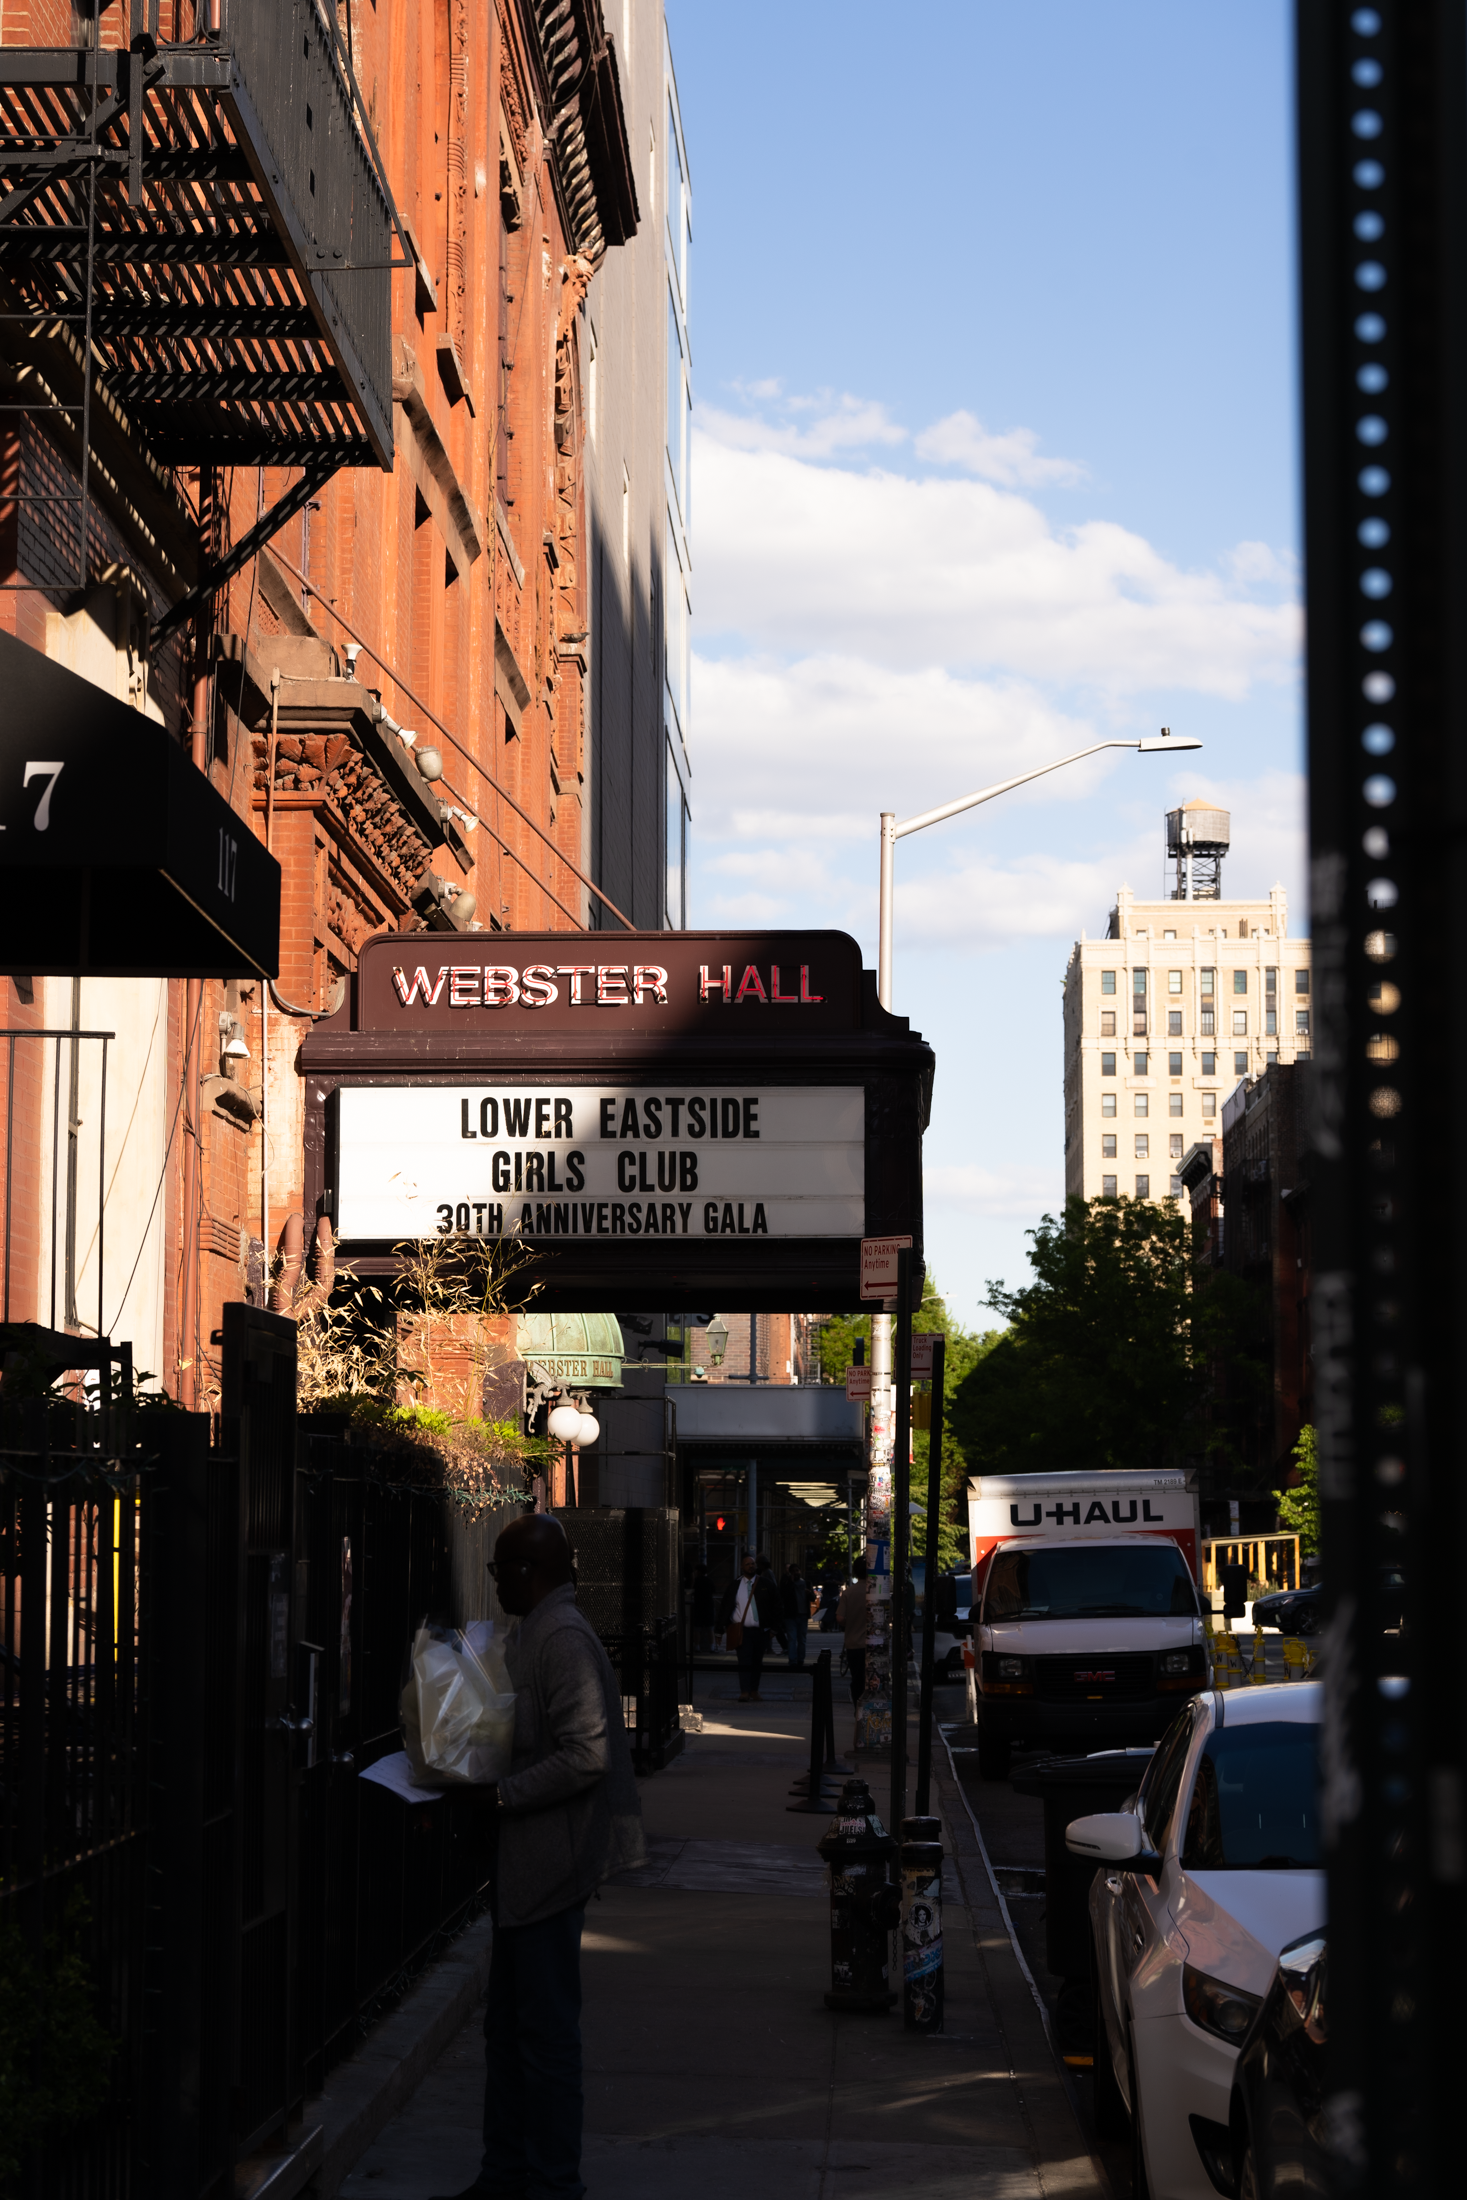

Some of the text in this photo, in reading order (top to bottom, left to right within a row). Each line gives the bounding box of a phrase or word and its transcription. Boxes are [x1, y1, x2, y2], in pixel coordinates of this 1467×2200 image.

[217, 827, 238, 903] 117
[393, 965, 827, 1005] WEBSTER HALL
[461, 1097, 760, 1139] LOWER EASTSIDE
[491, 1150, 698, 1193] GIRLS CLUB
[436, 1202, 768, 1234] 30TH ANNIVERSARY GALA
[864, 1245, 873, 1256] NO
[864, 1258, 890, 1271] Anytime
[593, 1360, 614, 1378] HALL
[913, 1352, 924, 1360] Only
[1010, 1499, 1164, 1527] U-HAUL
[1073, 1670, 1116, 1682] GMC
